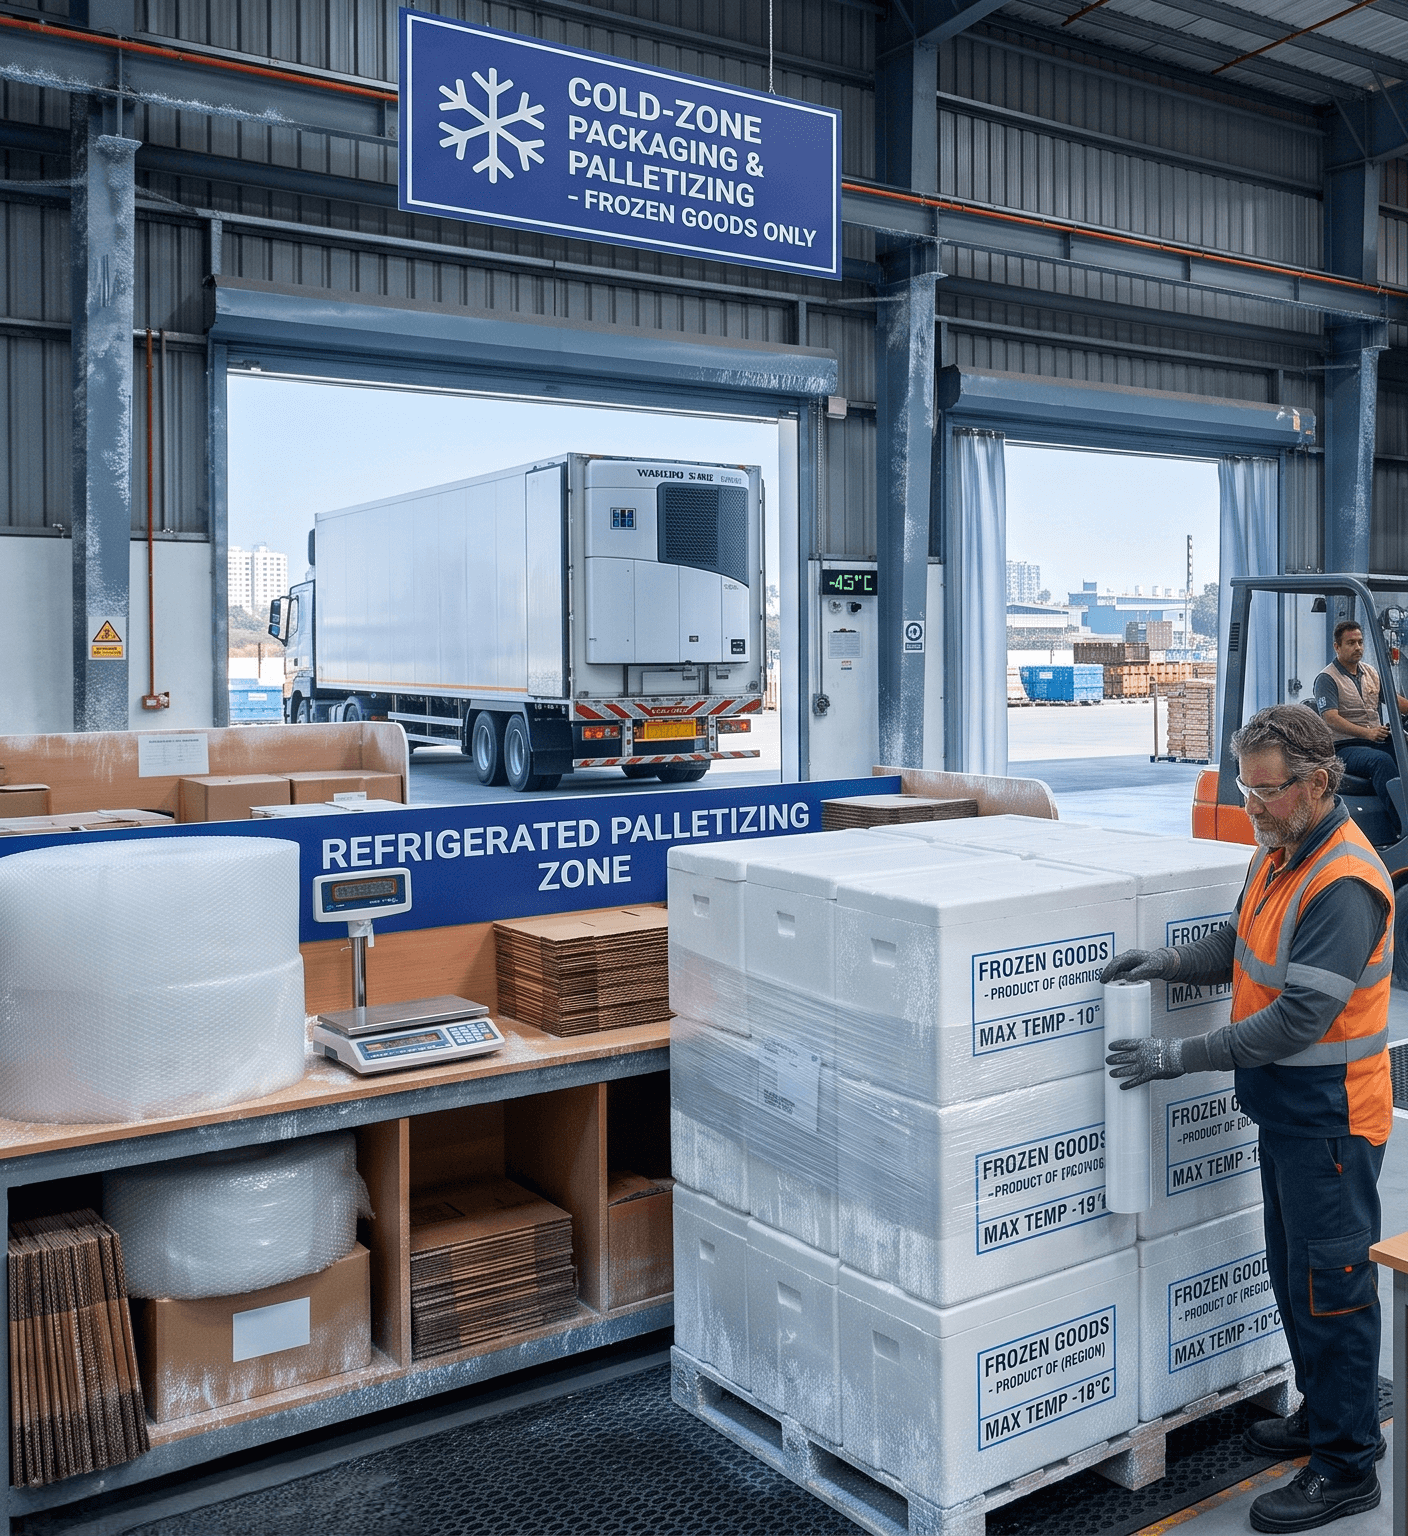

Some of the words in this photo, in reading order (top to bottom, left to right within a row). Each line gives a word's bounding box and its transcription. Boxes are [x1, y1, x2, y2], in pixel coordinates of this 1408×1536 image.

[568, 76, 762, 145] COLD-ZONE
[568, 114, 738, 173] PACKAGING
[745, 151, 765, 179] &
[568, 150, 755, 207] PALLETIZING
[585, 190, 675, 224] FROZEN
[682, 206, 758, 239] GOODS
[763, 222, 817, 248] ONLY
[321, 817, 600, 870] REFRIGERATED
[610, 801, 810, 846] PALLETIZING
[538, 854, 632, 892] ZONE
[979, 951, 1047, 982] FROZEN
[1052, 941, 1109, 969] GOODS
[991, 980, 1040, 1001] PRODUCT
[1042, 976, 1055, 991] OF
[1172, 983, 1203, 1004] MAX
[980, 1021, 1017, 1048] MAX
[1021, 1012, 1065, 1038] TEMP
[1171, 1096, 1227, 1128] FROZEN
[1224, 1119, 1235, 1133] OF
[983, 1144, 1049, 1180] FROZEN
[1045, 1169, 1058, 1184] OF
[1172, 1162, 1203, 1188] MAX
[1206, 1150, 1243, 1177] TEMP
[984, 1217, 1020, 1245] MAX
[1024, 1203, 1068, 1232] TEMP
[1174, 1271, 1229, 1307] FROZEN
[1184, 1296, 1225, 1322] PRODUCT
[1226, 1291, 1238, 1306] OF
[985, 1336, 1049, 1378] FROZEN
[1055, 1316, 1110, 1352] GOODS
[1174, 1337, 1206, 1366] MAX
[1208, 1322, 1245, 1351] TEMP
[996, 1365, 1043, 1395] PRODUCT
[1045, 1359, 1058, 1375] OF
[1061, 1341, 1106, 1373] (REGION)
[985, 1409, 1021, 1441] MAX
[1025, 1392, 1068, 1424] TEMP
[1071, 1376, 1110, 1404] -18°C
